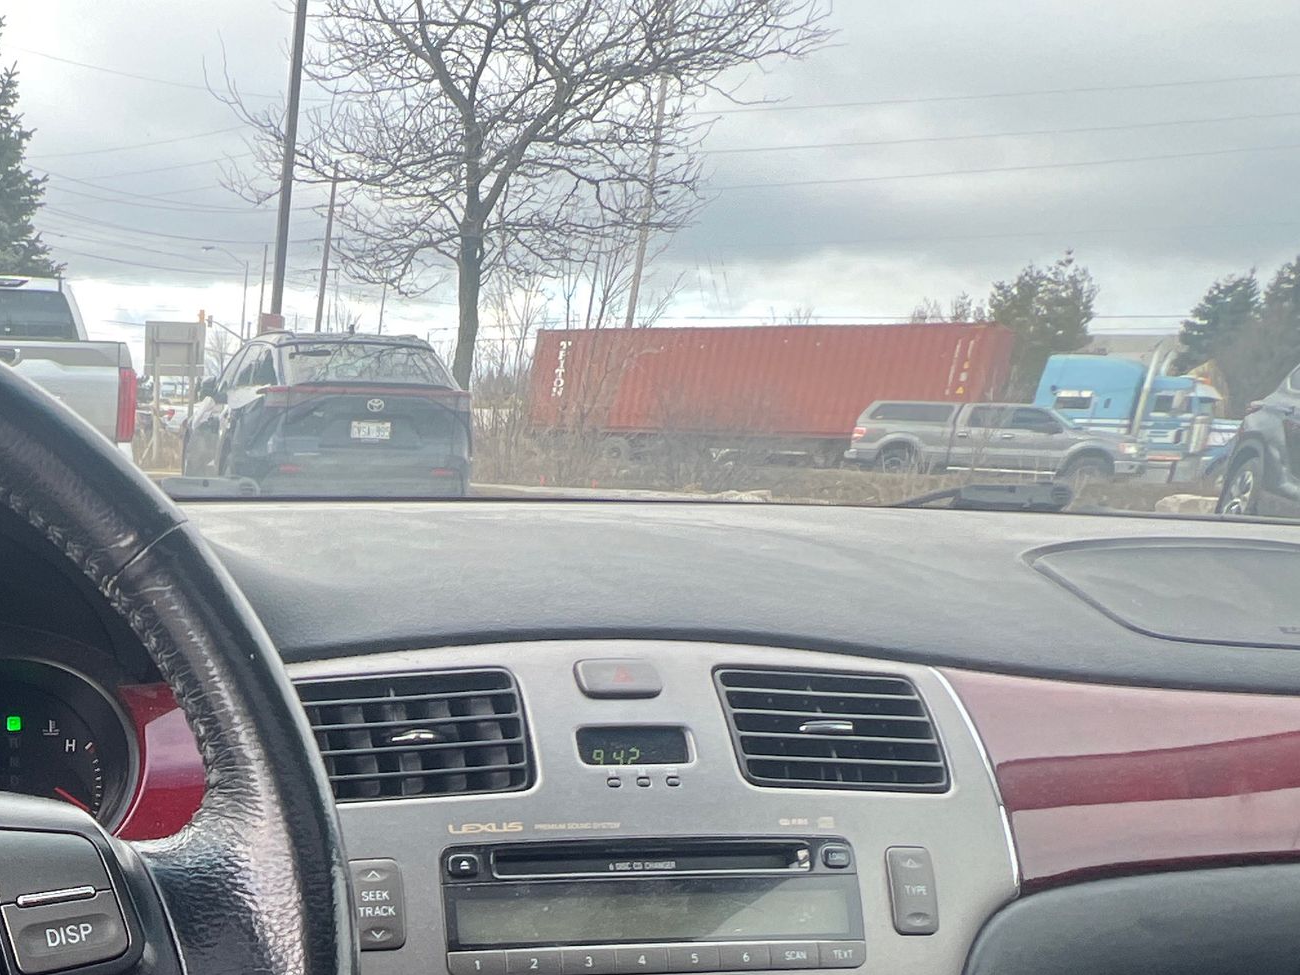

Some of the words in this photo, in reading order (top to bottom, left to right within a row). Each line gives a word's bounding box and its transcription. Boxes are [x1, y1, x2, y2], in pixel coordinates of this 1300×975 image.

[65, 739, 76, 752] H
[448, 822, 523, 835] LEXUS
[361, 890, 390, 902] SEEK
[904, 885, 927, 896] TYPE
[359, 905, 396, 917] TRACK
[45, 923, 93, 947] DISP
[638, 955, 646, 965] 4
[691, 953, 698, 964] 5
[742, 952, 750, 962] 6
[785, 951, 807, 960] SCAN
[833, 950, 853, 959] TEXT
[474, 960, 480, 970] 1
[530, 958, 538, 969] 2
[585, 957, 592, 968] 3
